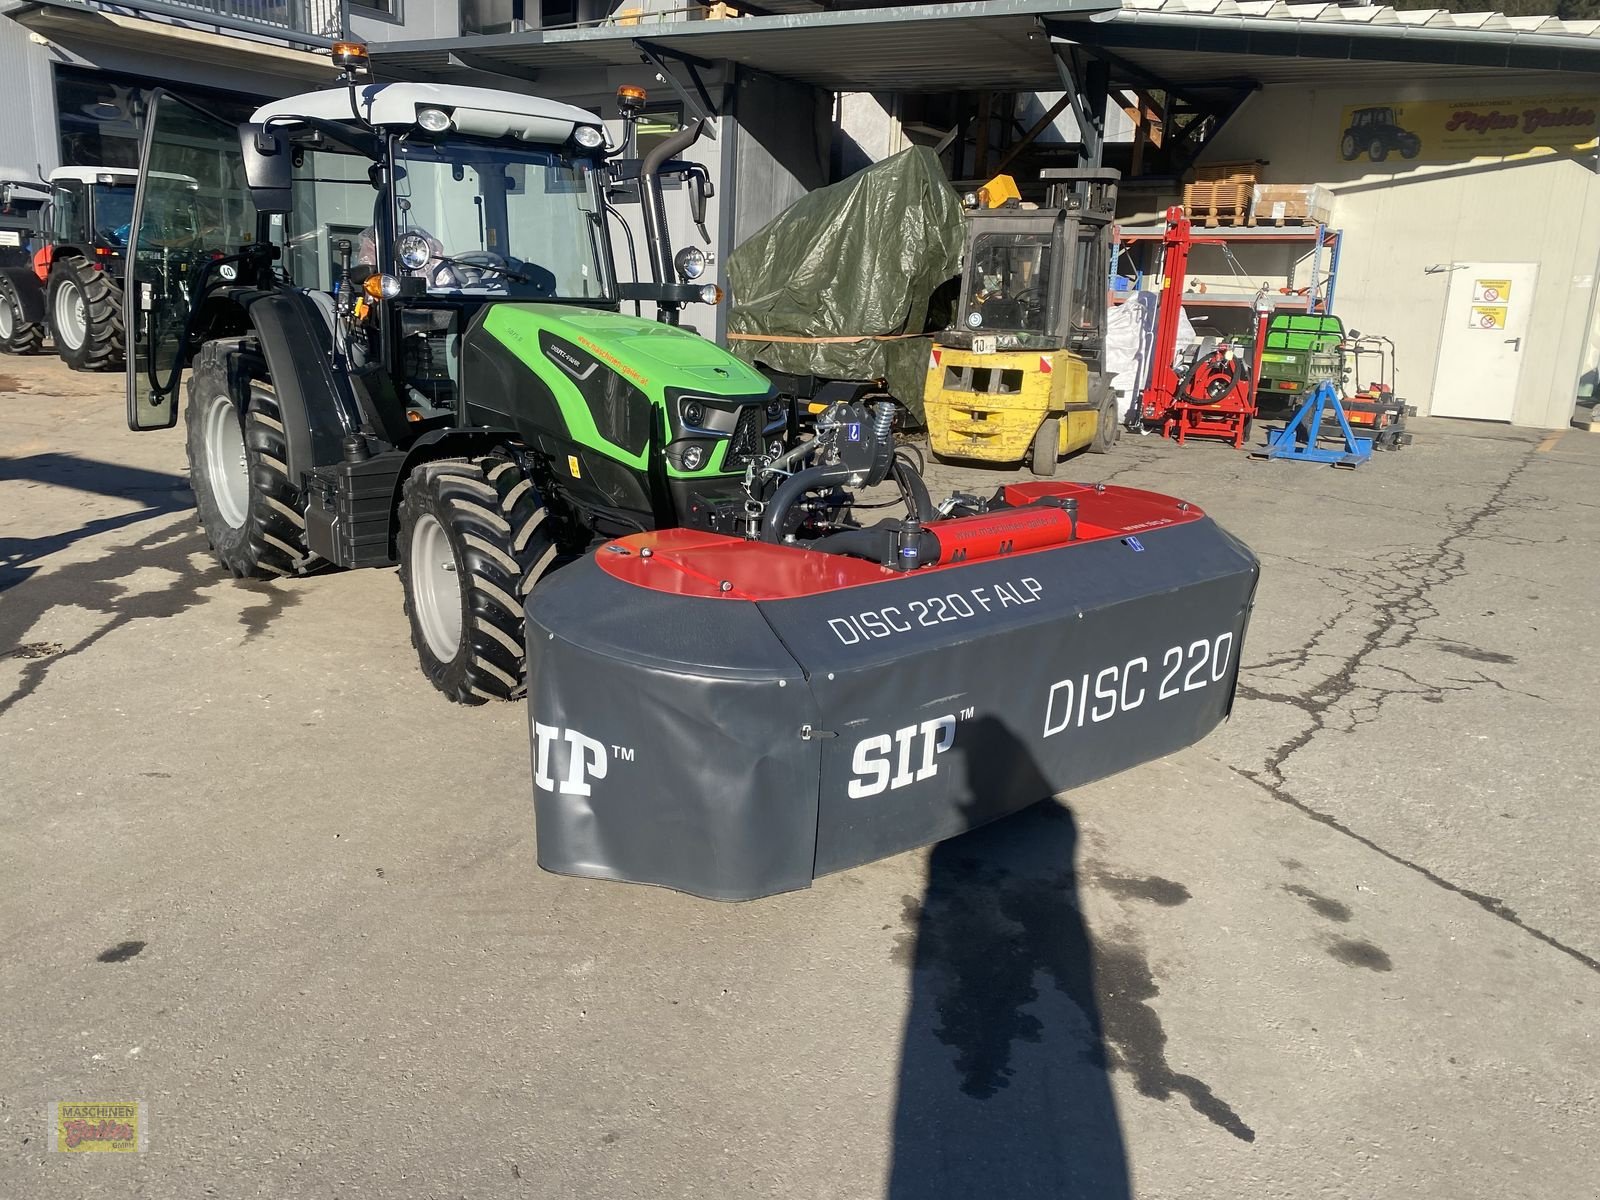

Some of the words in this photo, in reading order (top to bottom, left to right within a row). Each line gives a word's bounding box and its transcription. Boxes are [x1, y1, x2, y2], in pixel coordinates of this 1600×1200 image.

[550, 344, 581, 368] DEUTZ-FAHR
[974, 339, 985, 353] 10
[827, 606, 912, 645] DISC
[908, 593, 975, 627] 220
[970, 587, 991, 612] F
[993, 577, 1043, 608] ALP
[1043, 656, 1148, 739] DISC
[1158, 631, 1233, 701] 220
[532, 716, 608, 797] IP
[847, 713, 957, 799] SIP
